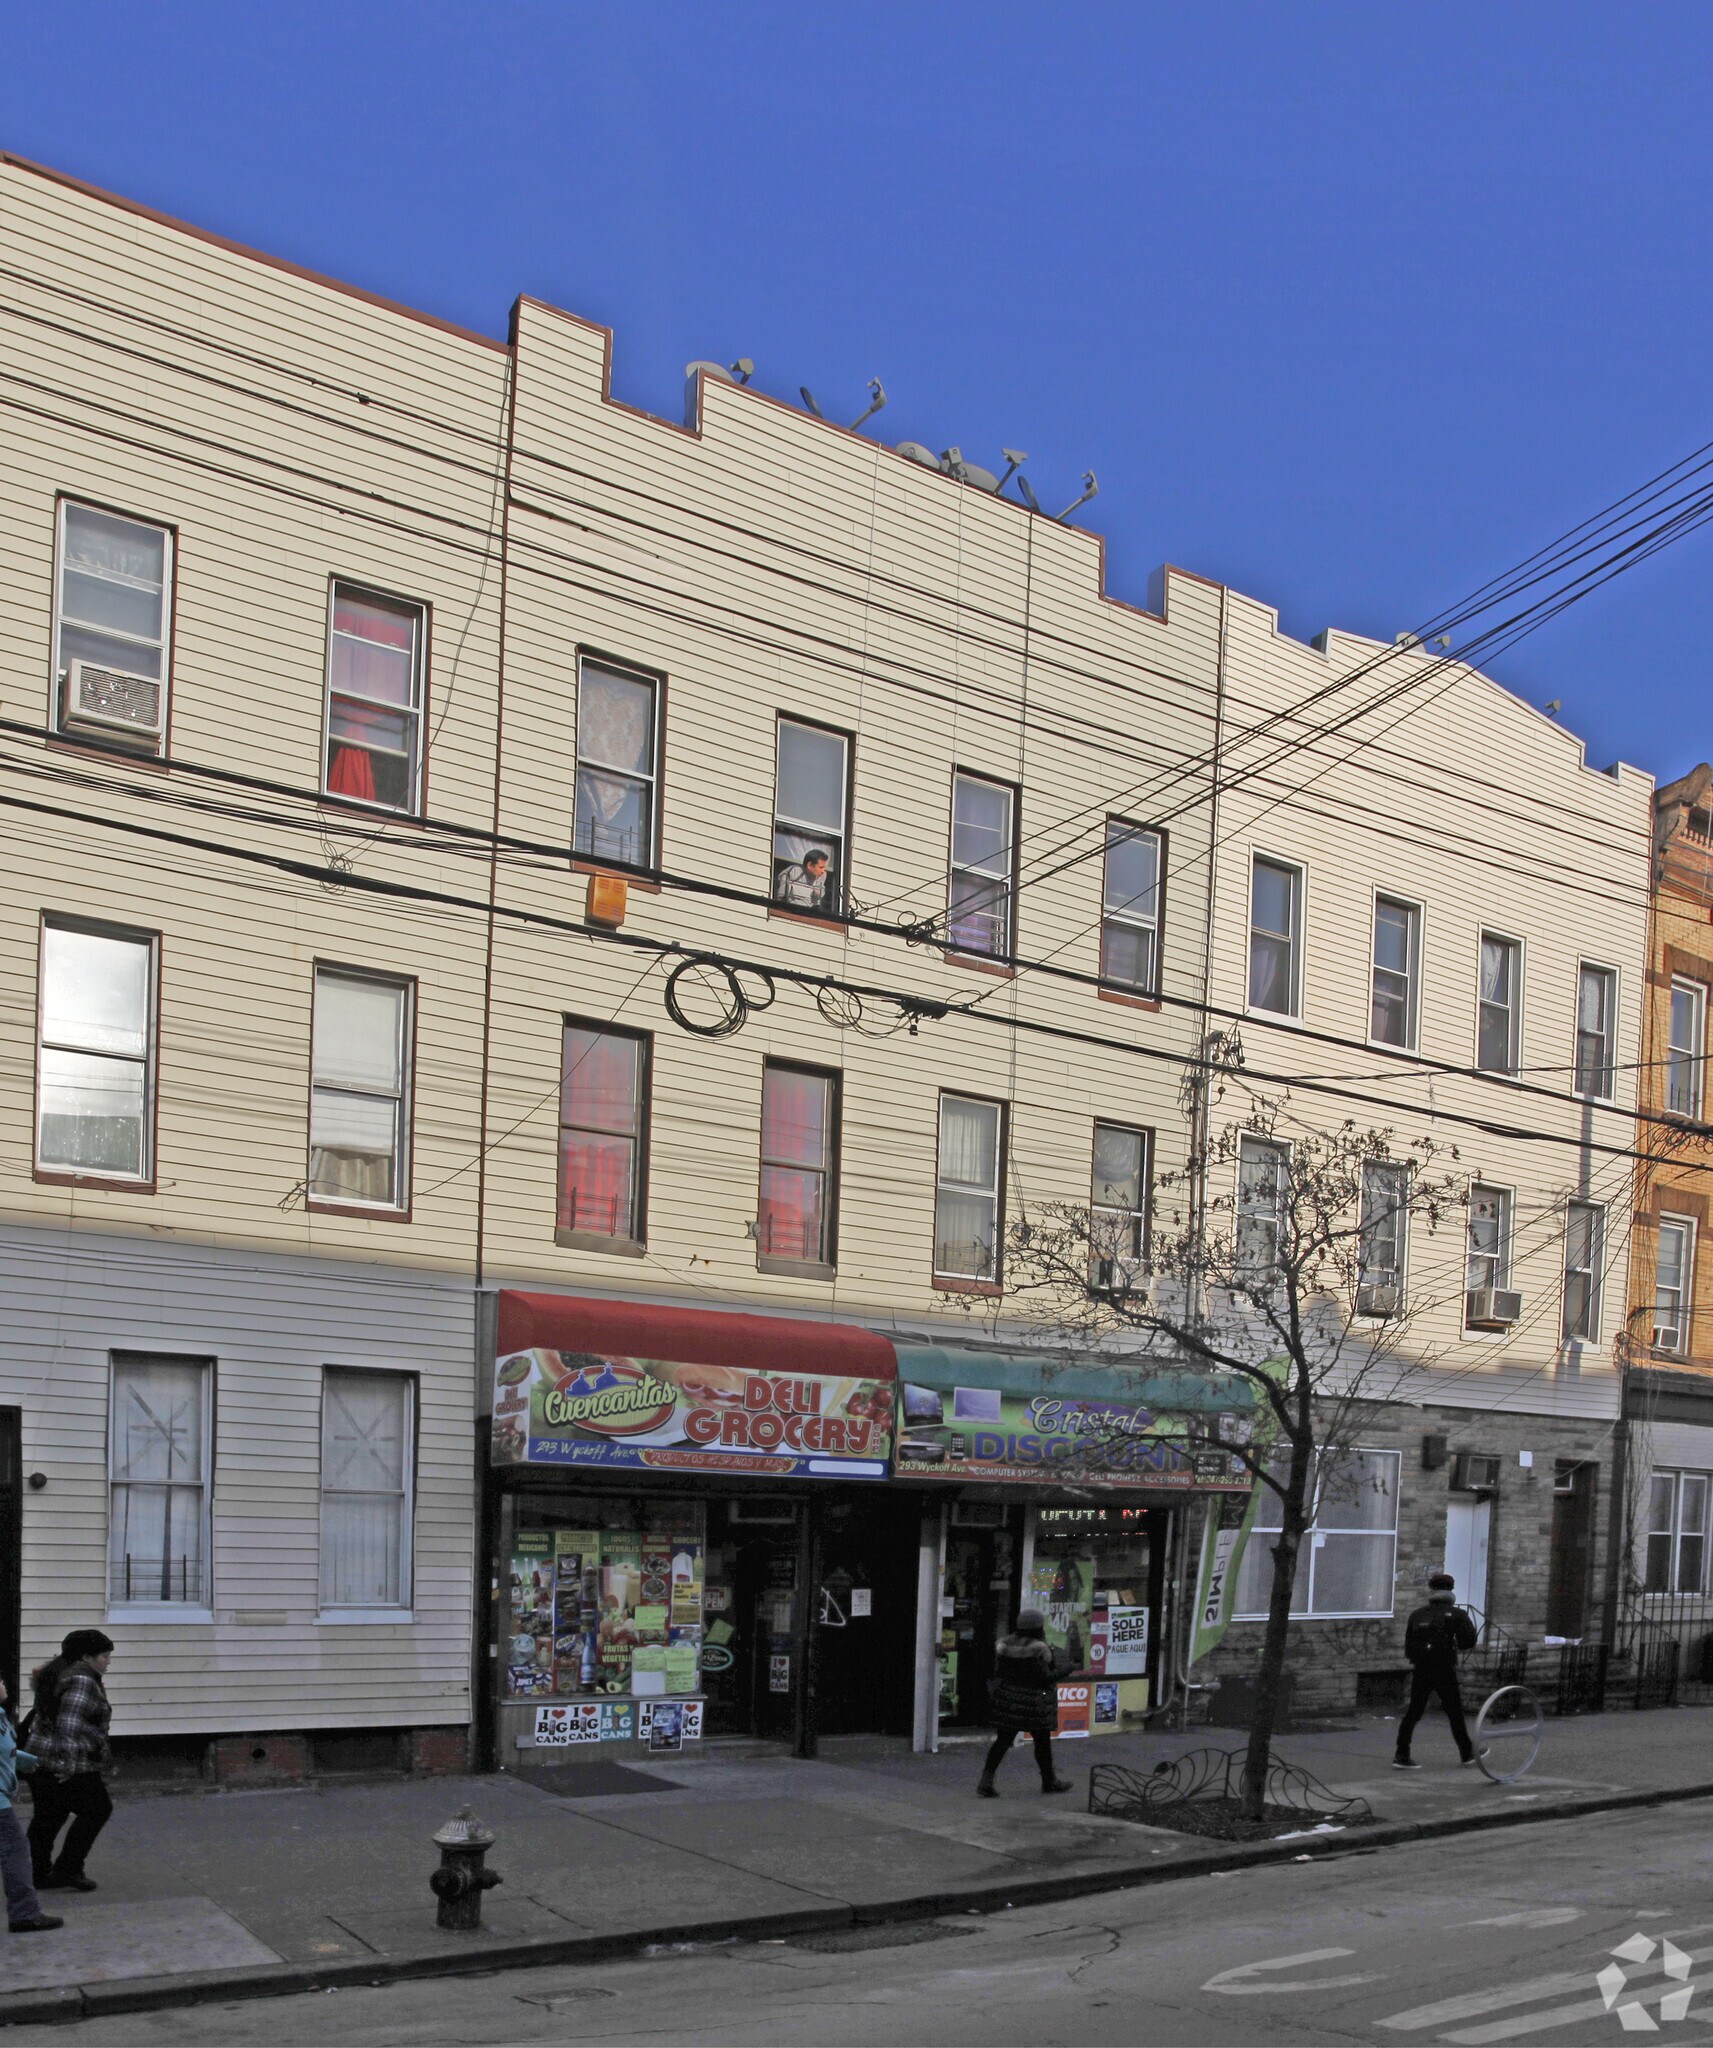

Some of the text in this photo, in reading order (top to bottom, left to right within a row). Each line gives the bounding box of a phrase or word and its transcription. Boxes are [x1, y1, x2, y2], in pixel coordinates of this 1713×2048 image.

[545, 1374, 676, 1425] Cuencanitas
[744, 1375, 823, 1414] DELI
[1030, 1396, 1147, 1434] Cristal
[684, 1408, 873, 1453] GROCERY
[871, 1423, 881, 1453] CORP
[535, 1441, 558, 1454] 293
[973, 1431, 1185, 1472] DISCOUNT
[899, 1460, 916, 1471] 293
[917, 1461, 950, 1473] Wyckoff
[974, 1466, 1015, 1477] COMPUTER
[705, 1597, 724, 1608] PEN
[1112, 1617, 1144, 1631] SOLD
[1112, 1629, 1144, 1643] HERE
[604, 1644, 628, 1653] FRUTAS
[1106, 1643, 1146, 1654] PAGUE AQUI
[543, 1709, 549, 1719] I
[574, 1707, 579, 1717] I
[605, 1705, 612, 1716] I
[536, 1735, 567, 1744] CANS
[569, 1732, 599, 1741] CANS
[601, 1730, 631, 1739] CANS
